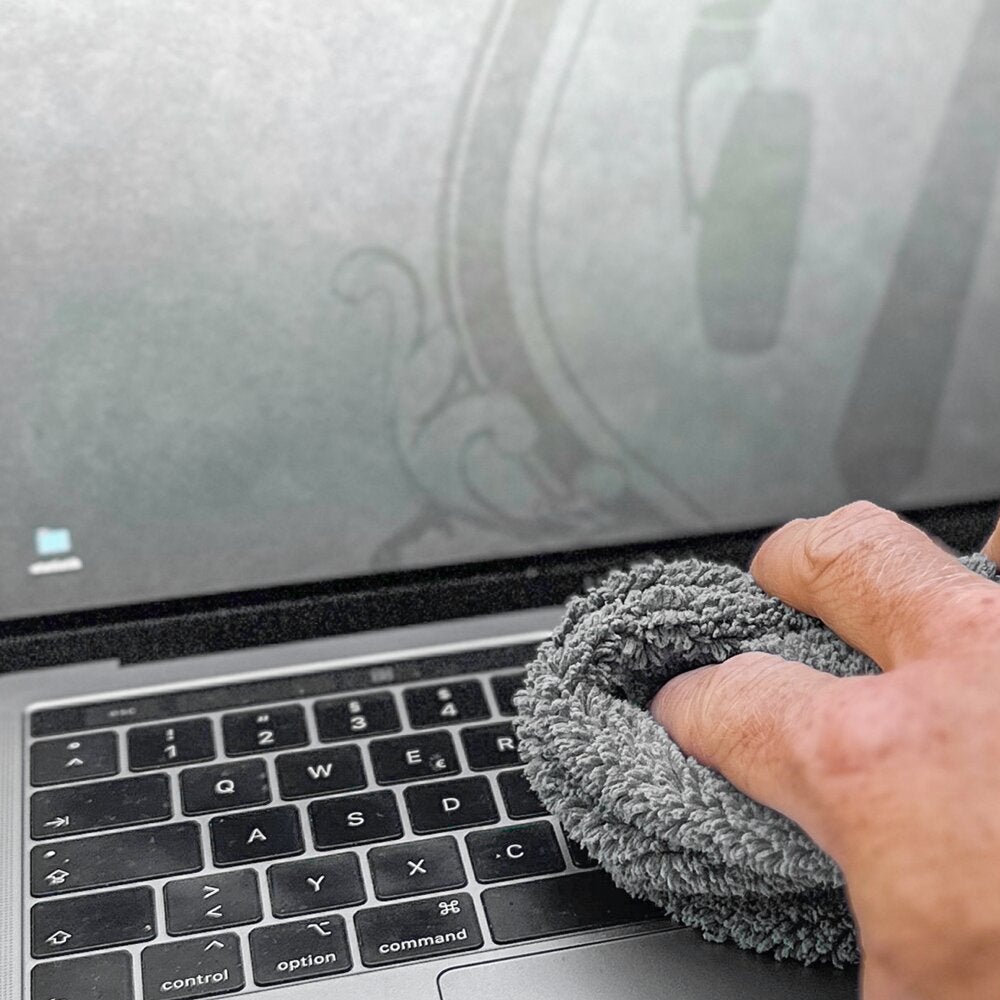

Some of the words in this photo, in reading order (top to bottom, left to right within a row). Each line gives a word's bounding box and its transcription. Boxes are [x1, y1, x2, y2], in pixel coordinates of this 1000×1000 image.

[440, 702, 458, 716] 4
[350, 715, 368, 730] 3
[258, 730, 275, 745] 2
[497, 737, 515, 751] R
[405, 749, 423, 764] E
[307, 763, 333, 779] W
[215, 779, 235, 794] Q
[442, 797, 461, 812] D
[347, 811, 365, 827] S
[247, 827, 267, 843] A
[506, 843, 524, 859] C
[407, 858, 427, 876] X
[307, 875, 325, 892] Y
[378, 928, 469, 955] command
[277, 953, 337, 973] option
[160, 968, 229, 991] control
